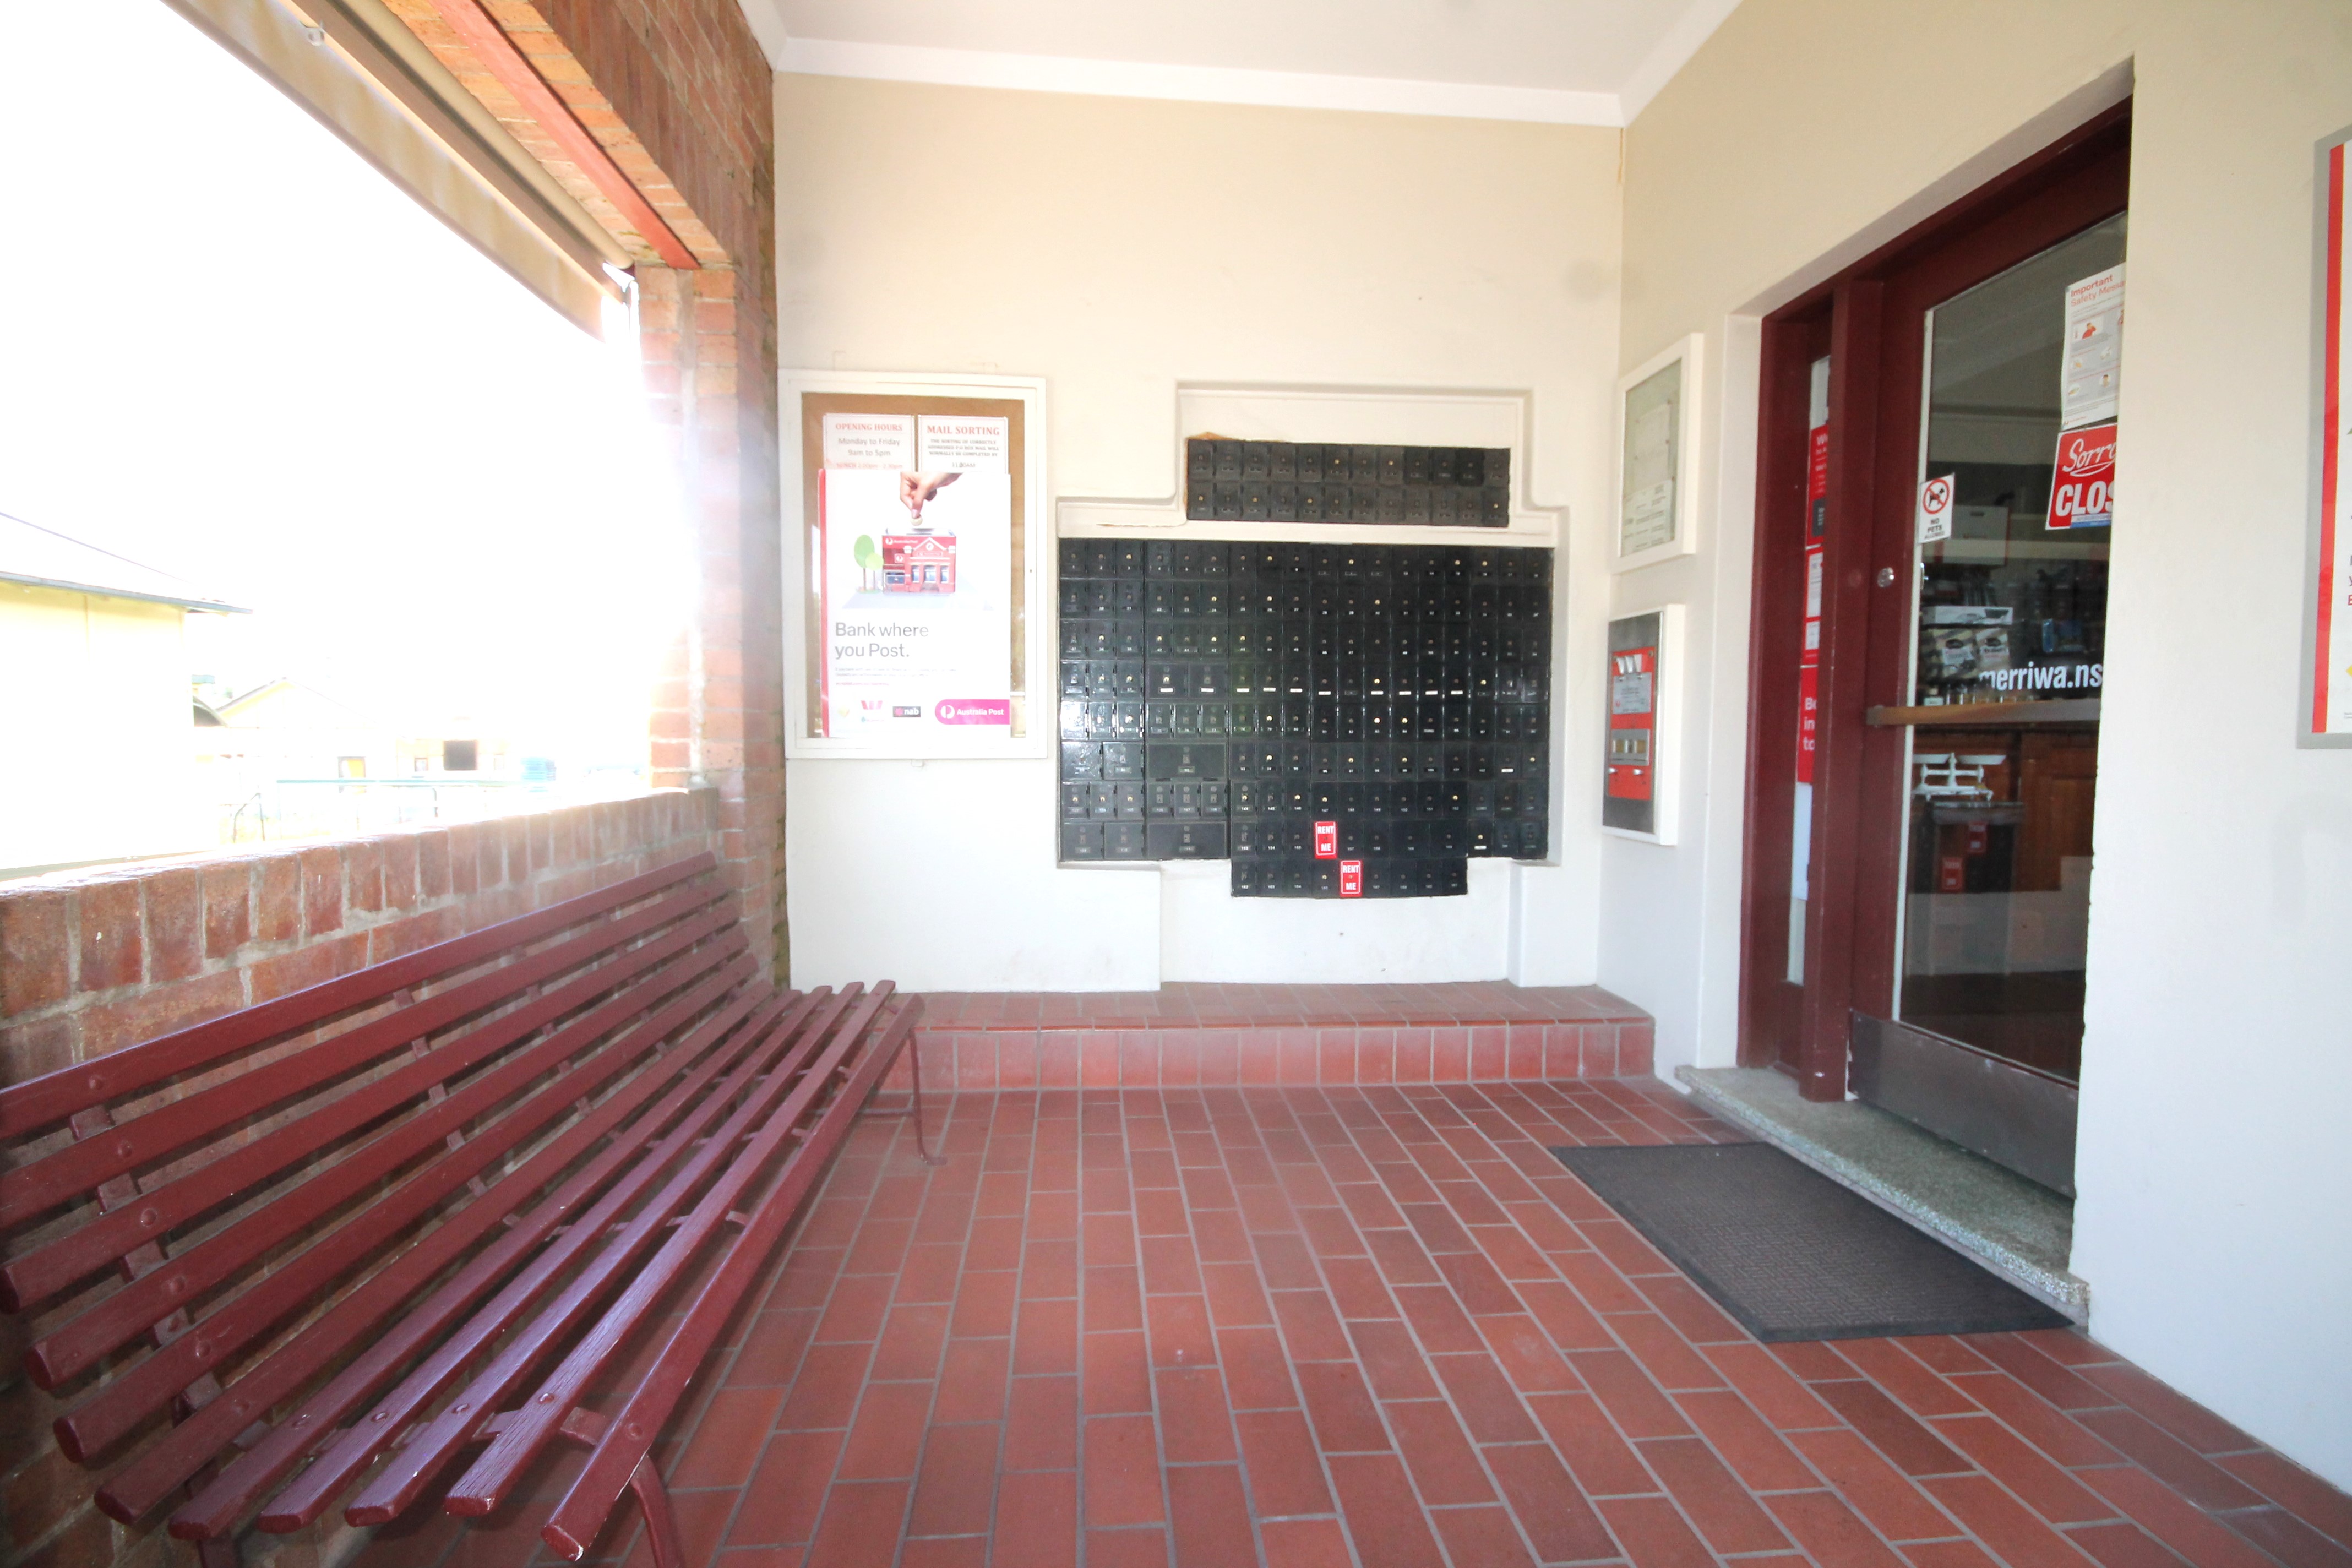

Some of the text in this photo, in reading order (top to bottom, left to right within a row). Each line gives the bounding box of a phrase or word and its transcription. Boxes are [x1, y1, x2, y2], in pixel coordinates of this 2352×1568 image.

[2071, 274, 2113, 297] Important
[2071, 292, 2097, 306] Safety
[927, 426, 1000, 435] MAIL SORTING
[839, 438, 867, 446] Monday
[879, 438, 900, 446] Friday
[1928, 525, 1942, 533] PETS
[836, 622, 929, 637] Bank where
[835, 643, 910, 660] you Post.
